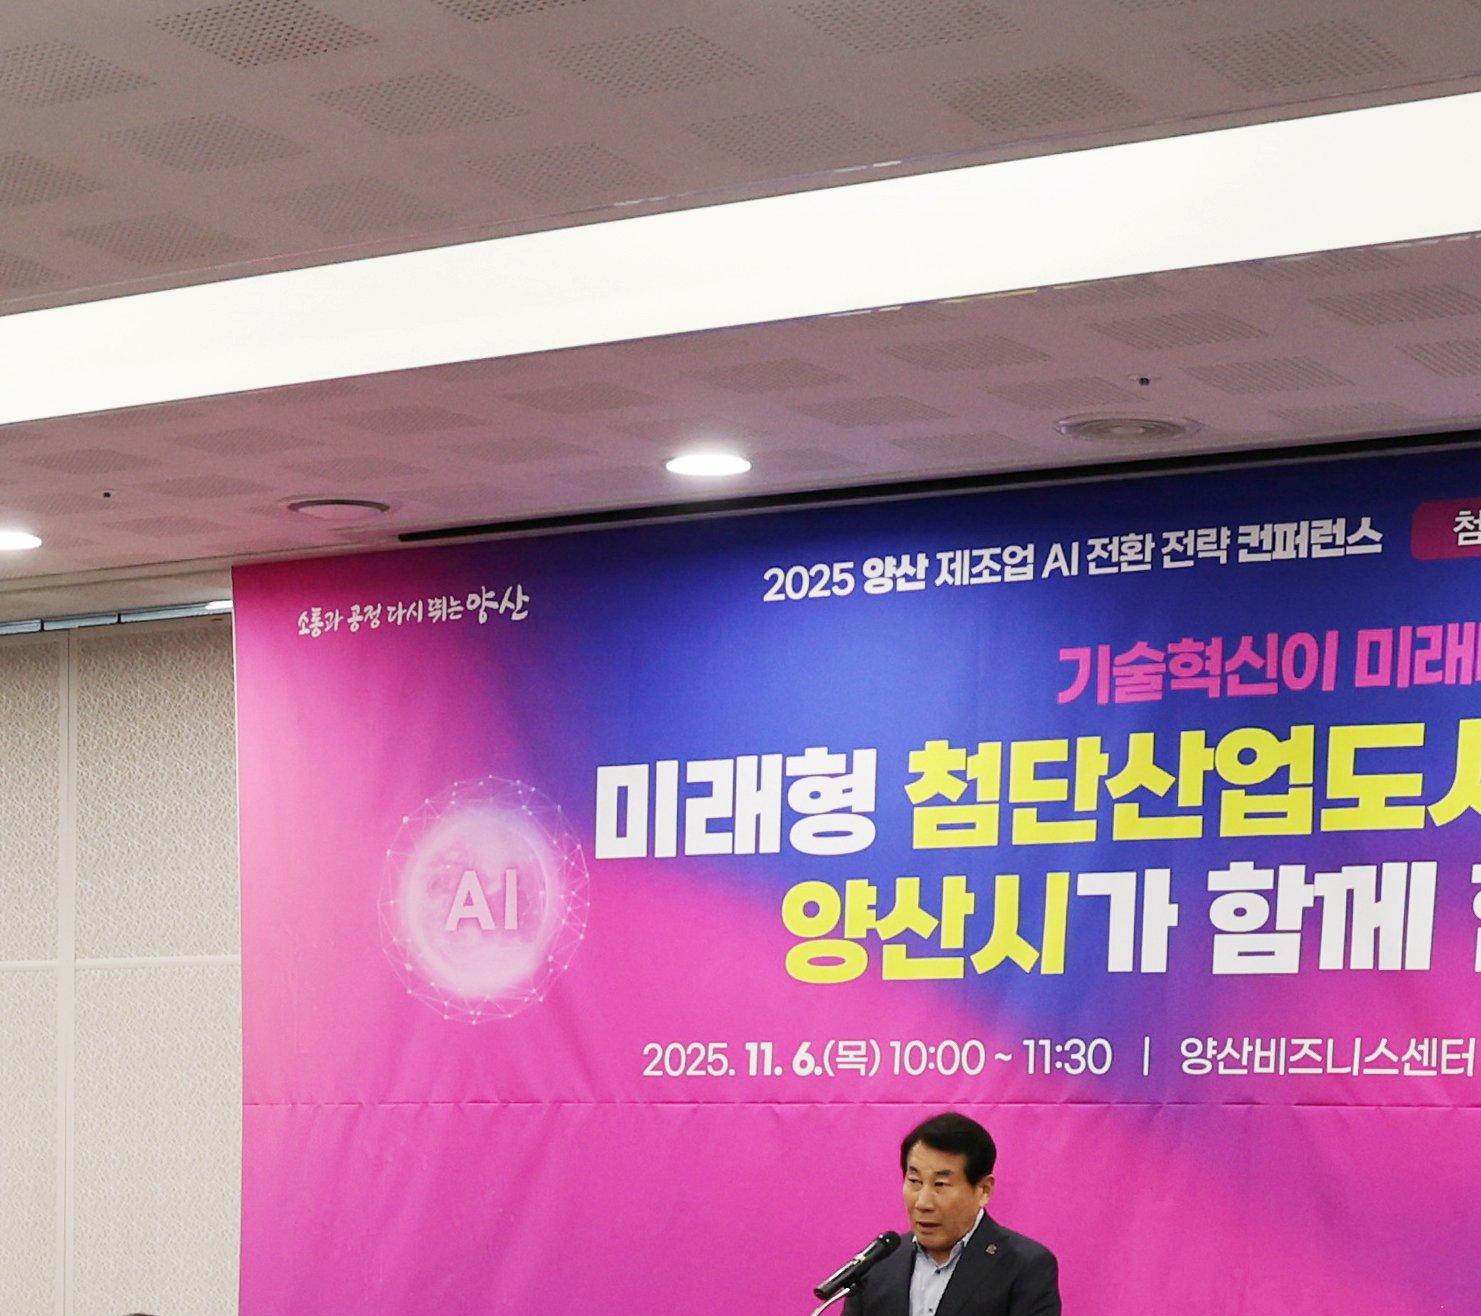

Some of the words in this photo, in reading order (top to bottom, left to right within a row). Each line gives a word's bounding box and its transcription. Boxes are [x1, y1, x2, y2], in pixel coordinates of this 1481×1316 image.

[763, 561, 856, 602] 2025
[862, 553, 929, 594] 양산
[934, 543, 1034, 587] 제조업
[1041, 541, 1079, 578] AI
[1086, 533, 1155, 575] 전환
[1161, 527, 1230, 568] 전략
[1238, 517, 1383, 563] 컨퍼런스
[297, 607, 343, 638] 소통과
[347, 603, 382, 632] 공정
[387, 599, 424, 625] 다시
[427, 596, 464, 623] 뛰는
[466, 585, 530, 624] 양산
[1058, 630, 1338, 705] 기술혁신이
[595, 746, 878, 860] 미래형
[444, 868, 518, 932] AI
[781, 868, 1179, 984] 양산시가
[1207, 861, 1437, 975] 함께
[642, 1042, 736, 1077] 2025.
[745, 1041, 783, 1076] 11.
[792, 1039, 881, 1078] 6.(목)
[889, 1039, 986, 1076] 10:00
[1022, 1038, 1113, 1075] 11:30
[1180, 1037, 1476, 1078] 양산비즈니스센터
